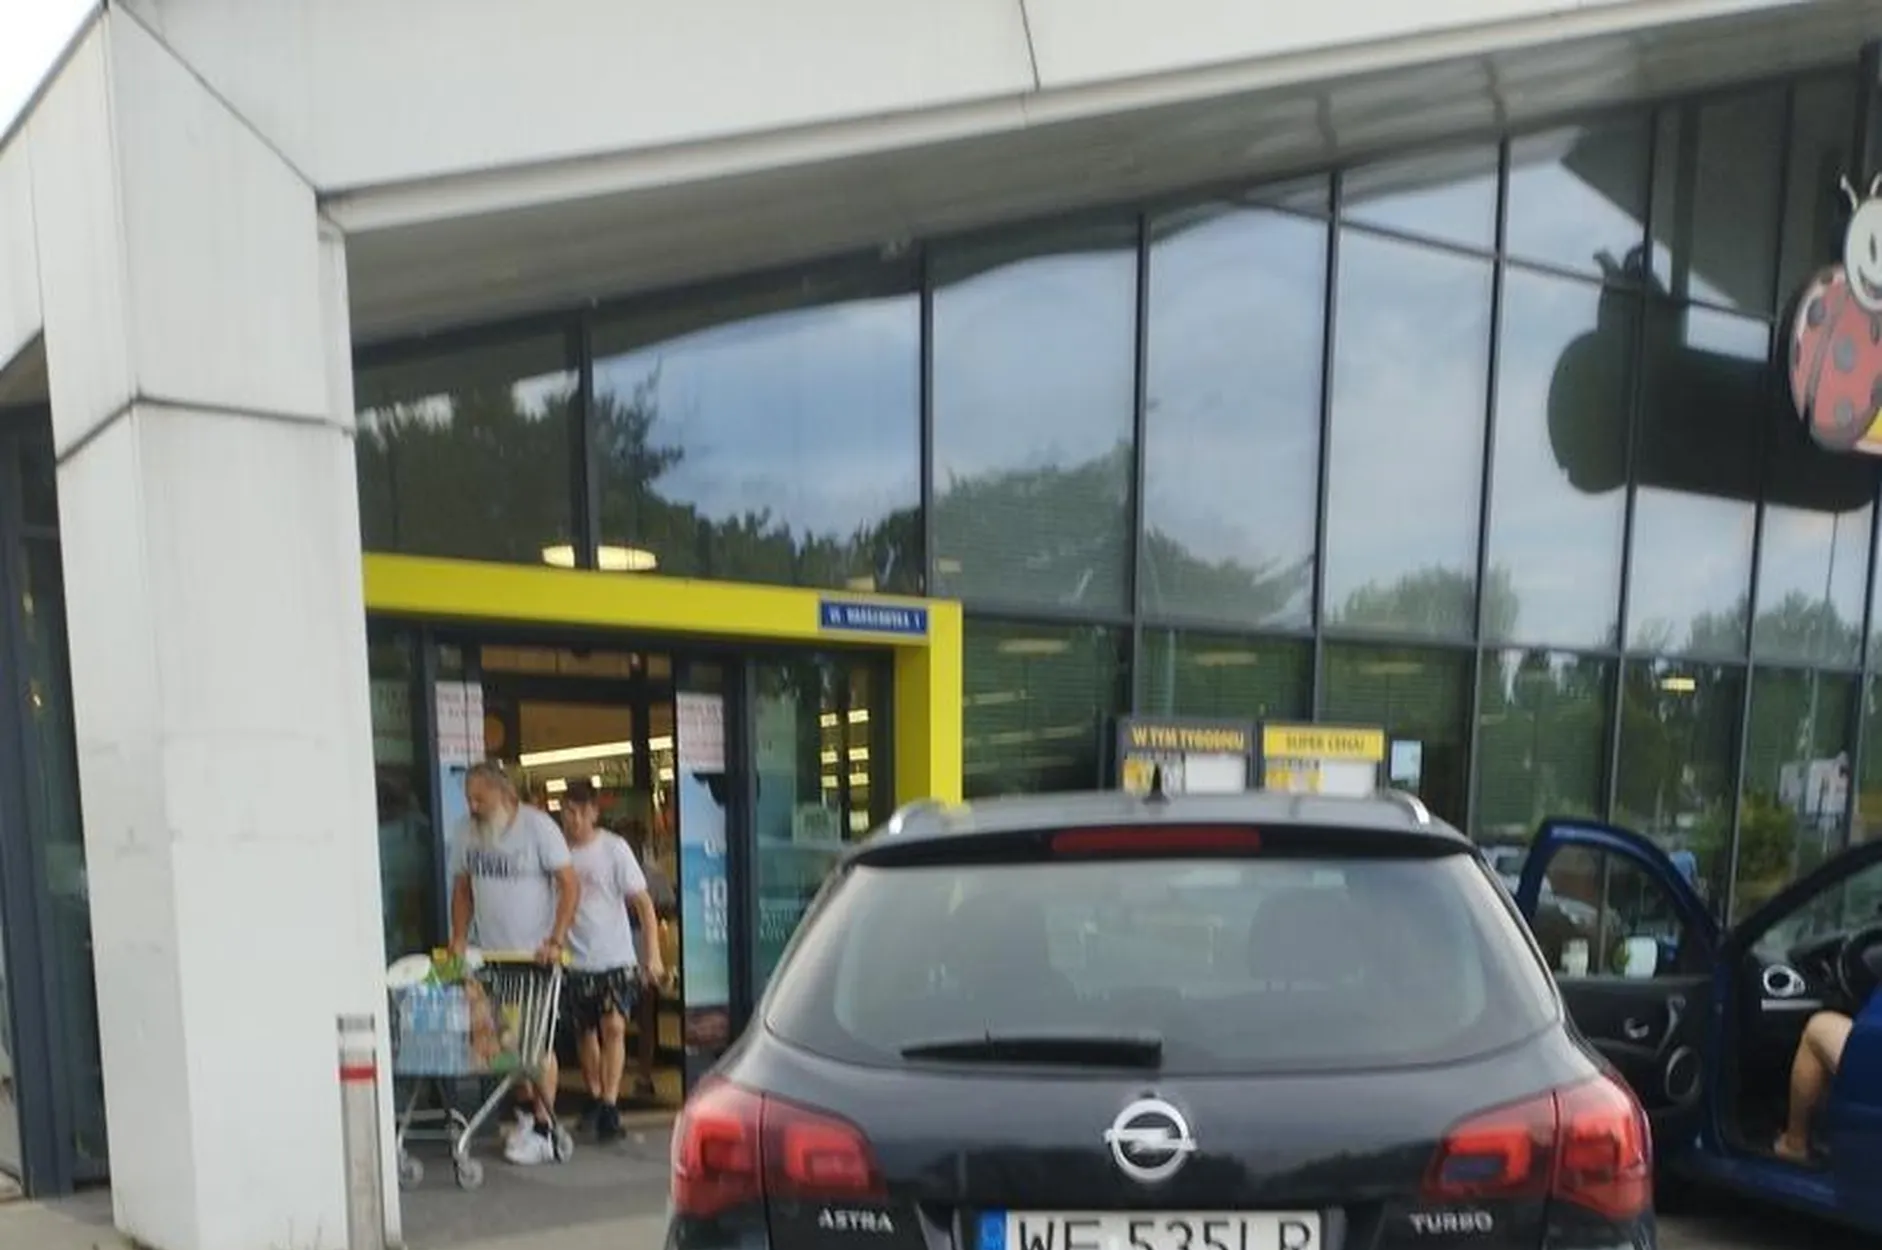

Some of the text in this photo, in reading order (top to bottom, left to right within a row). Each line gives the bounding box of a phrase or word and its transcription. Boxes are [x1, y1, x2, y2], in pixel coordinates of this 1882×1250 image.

[1131, 724, 1147, 748] W
[1149, 725, 1178, 749] TYM
[1286, 734, 1324, 750] SUPER
[818, 1207, 895, 1234] ASTRA
[1408, 1211, 1494, 1235] TURBO
